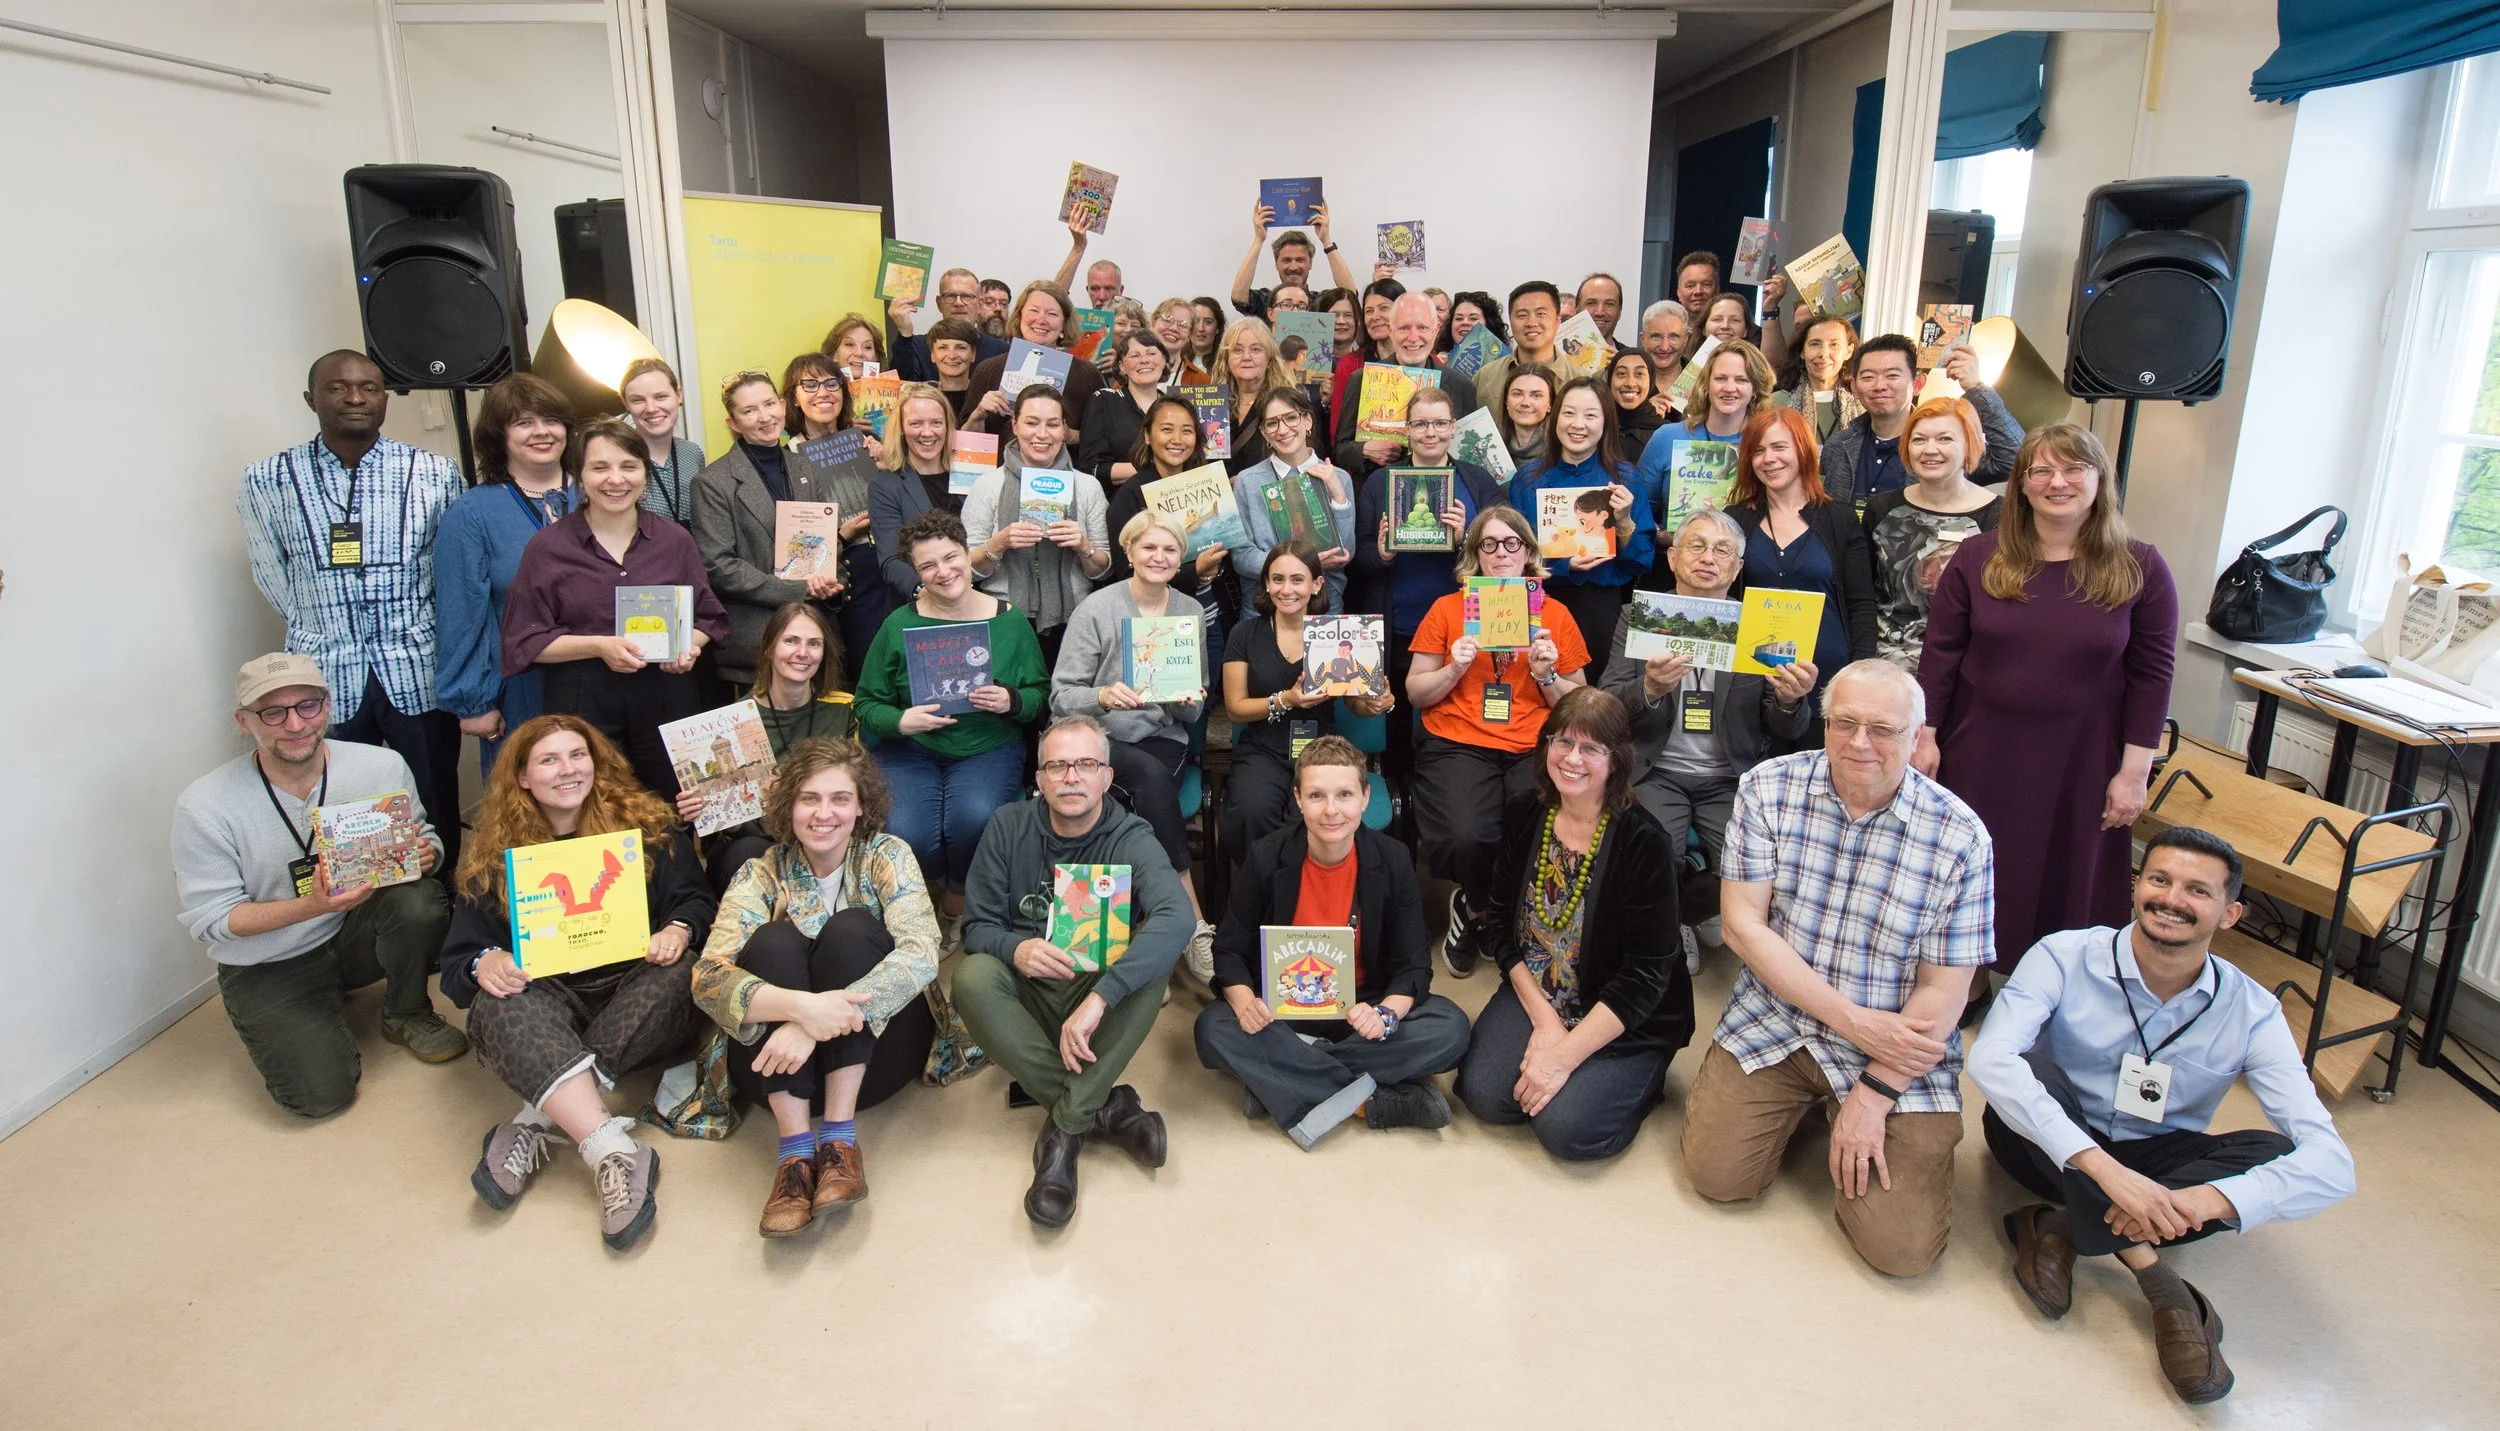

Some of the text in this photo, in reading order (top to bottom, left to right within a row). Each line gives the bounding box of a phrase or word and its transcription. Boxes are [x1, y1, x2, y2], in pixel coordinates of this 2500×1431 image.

[1083, 189, 1100, 200] ZOO
[709, 235, 737, 247] Tartu
[1180, 386, 1194, 394] HAVE
[1196, 398, 1225, 406] VAMPIRE?
[827, 441, 862, 457] LUCCIOLA
[828, 452, 857, 467] MILANO
[1677, 465, 1713, 479] Cake
[1032, 480, 1062, 489] PRAGUE
[1157, 483, 1221, 514] NELAYAN
[1488, 594, 1520, 606] WHAT
[1490, 620, 1521, 634] PLAY
[915, 636, 971, 655] MARKET
[1174, 638, 1195, 648] ESEL
[1166, 655, 1193, 665] KATZE
[681, 713, 740, 739] KRAKÓW
[344, 818, 382, 829] BREMEN
